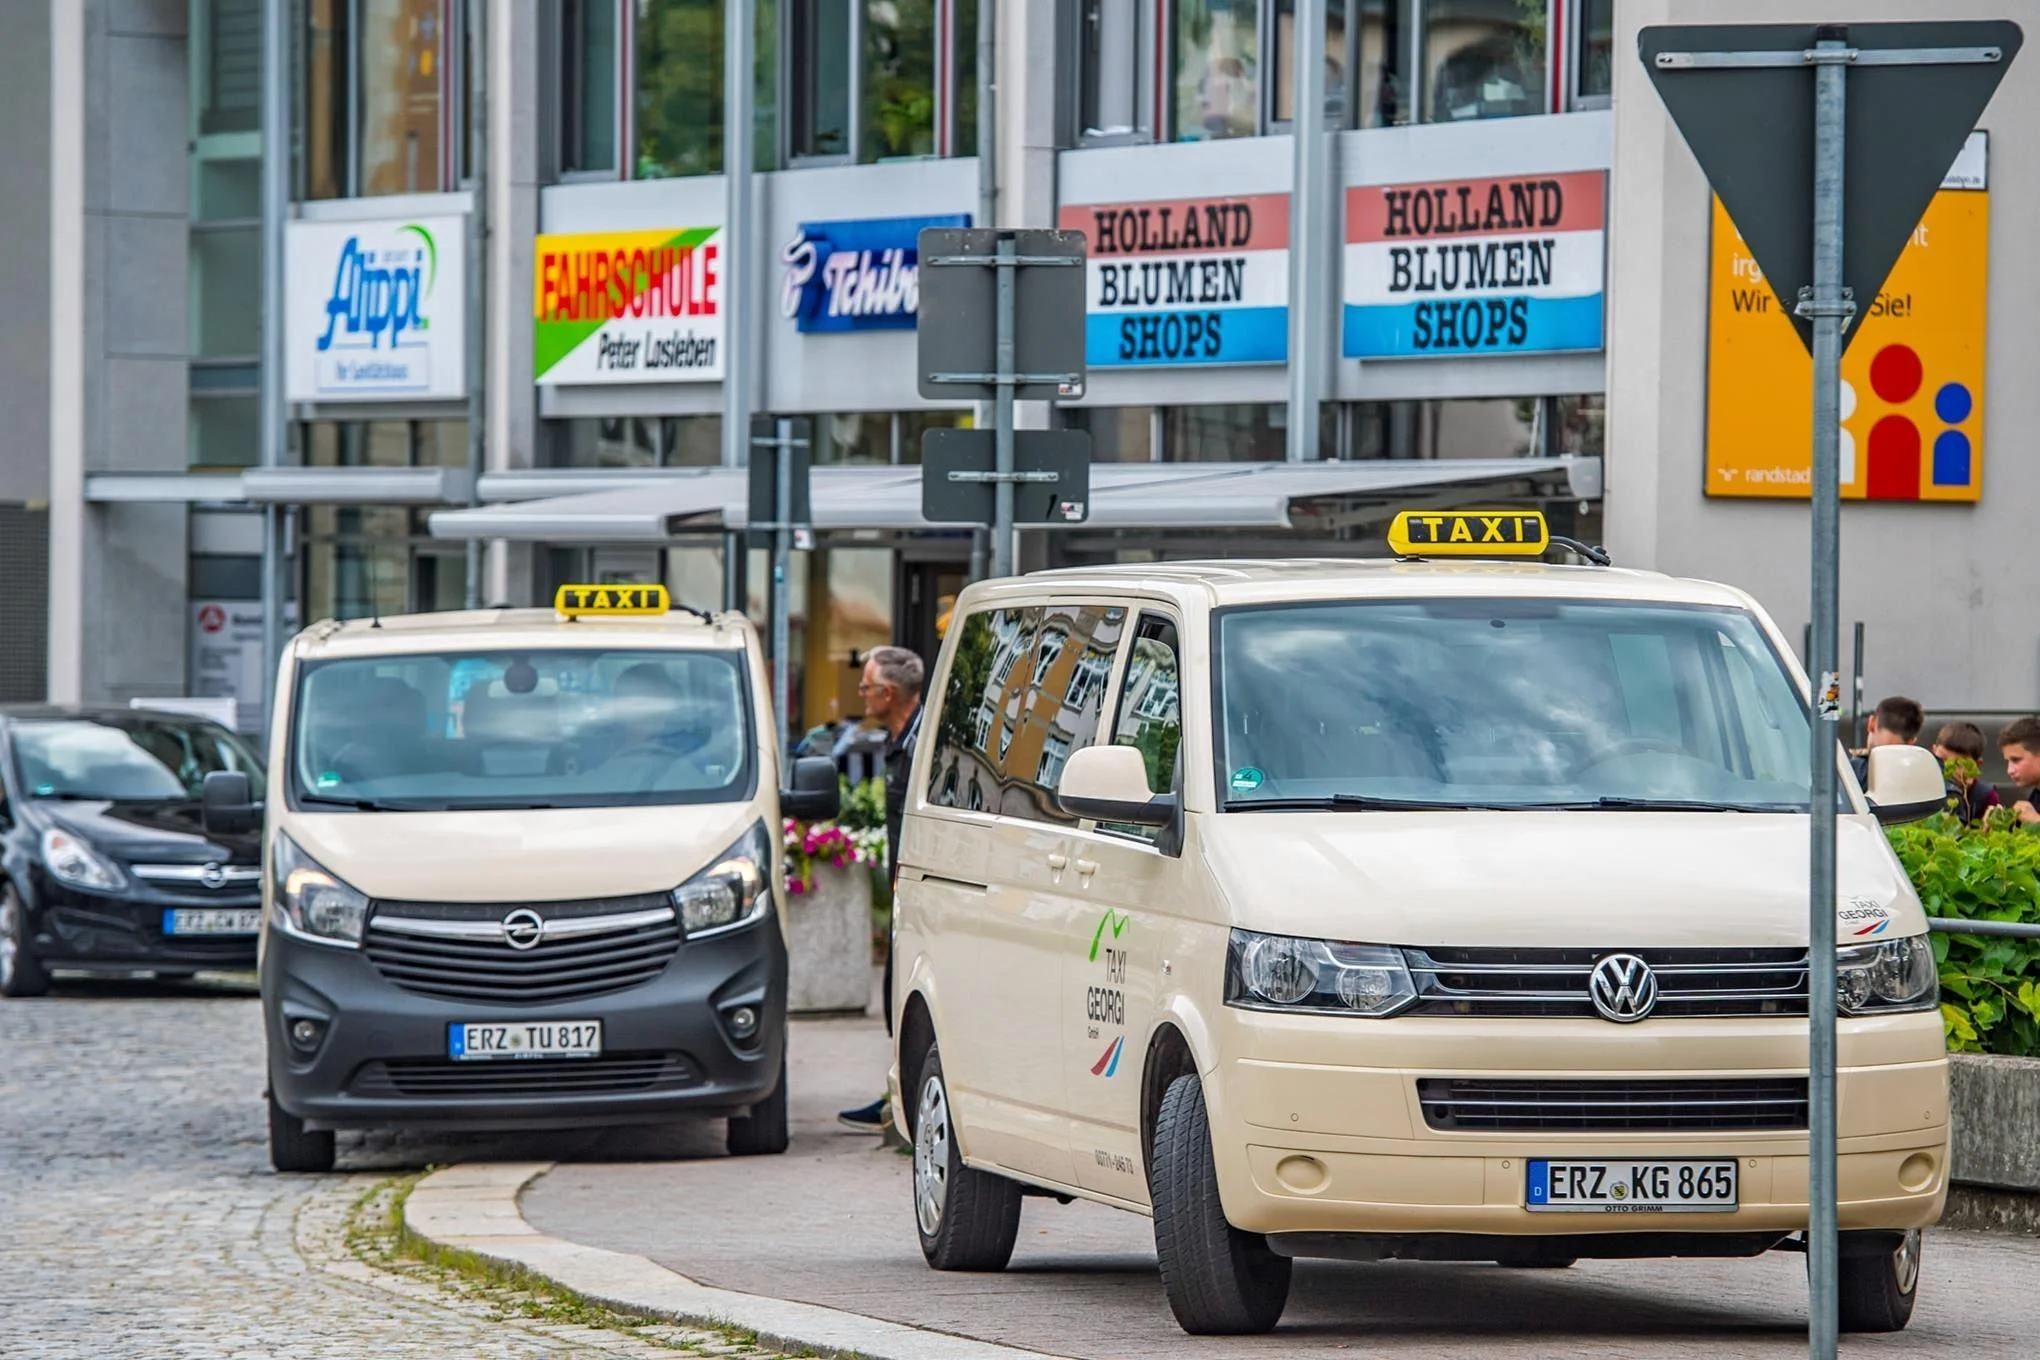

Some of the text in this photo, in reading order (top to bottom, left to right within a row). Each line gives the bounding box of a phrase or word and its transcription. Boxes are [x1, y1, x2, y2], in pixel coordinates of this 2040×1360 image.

[1384, 180, 1563, 237] HOLLAND
[1094, 203, 1253, 254] HOLLAND
[541, 246, 717, 321] FAHRSCHULE
[1100, 258, 1246, 307] BLUMEN
[1388, 238, 1556, 292] BLUMEN
[1732, 289, 1771, 313] Wir
[1870, 293, 1912, 318] Sie!
[1120, 313, 1222, 360] SHOPS
[1413, 297, 1528, 349] SHOPS
[597, 331, 640, 370] Peter
[1744, 466, 1812, 484] randstad
[1422, 517, 1523, 542] TAXI
[573, 590, 649, 608] TAXI
[1838, 908, 1888, 920] GEORGI
[1849, 900, 1881, 909] TAXI
[1106, 948, 1127, 984] TAXI
[1087, 986, 1125, 1025] GEORGI
[467, 1026, 596, 1050] ERZ TU 817
[1550, 1166, 1607, 1199] ERZ
[1632, 1166, 1669, 1199] KG
[1678, 1166, 1732, 1199] 865
